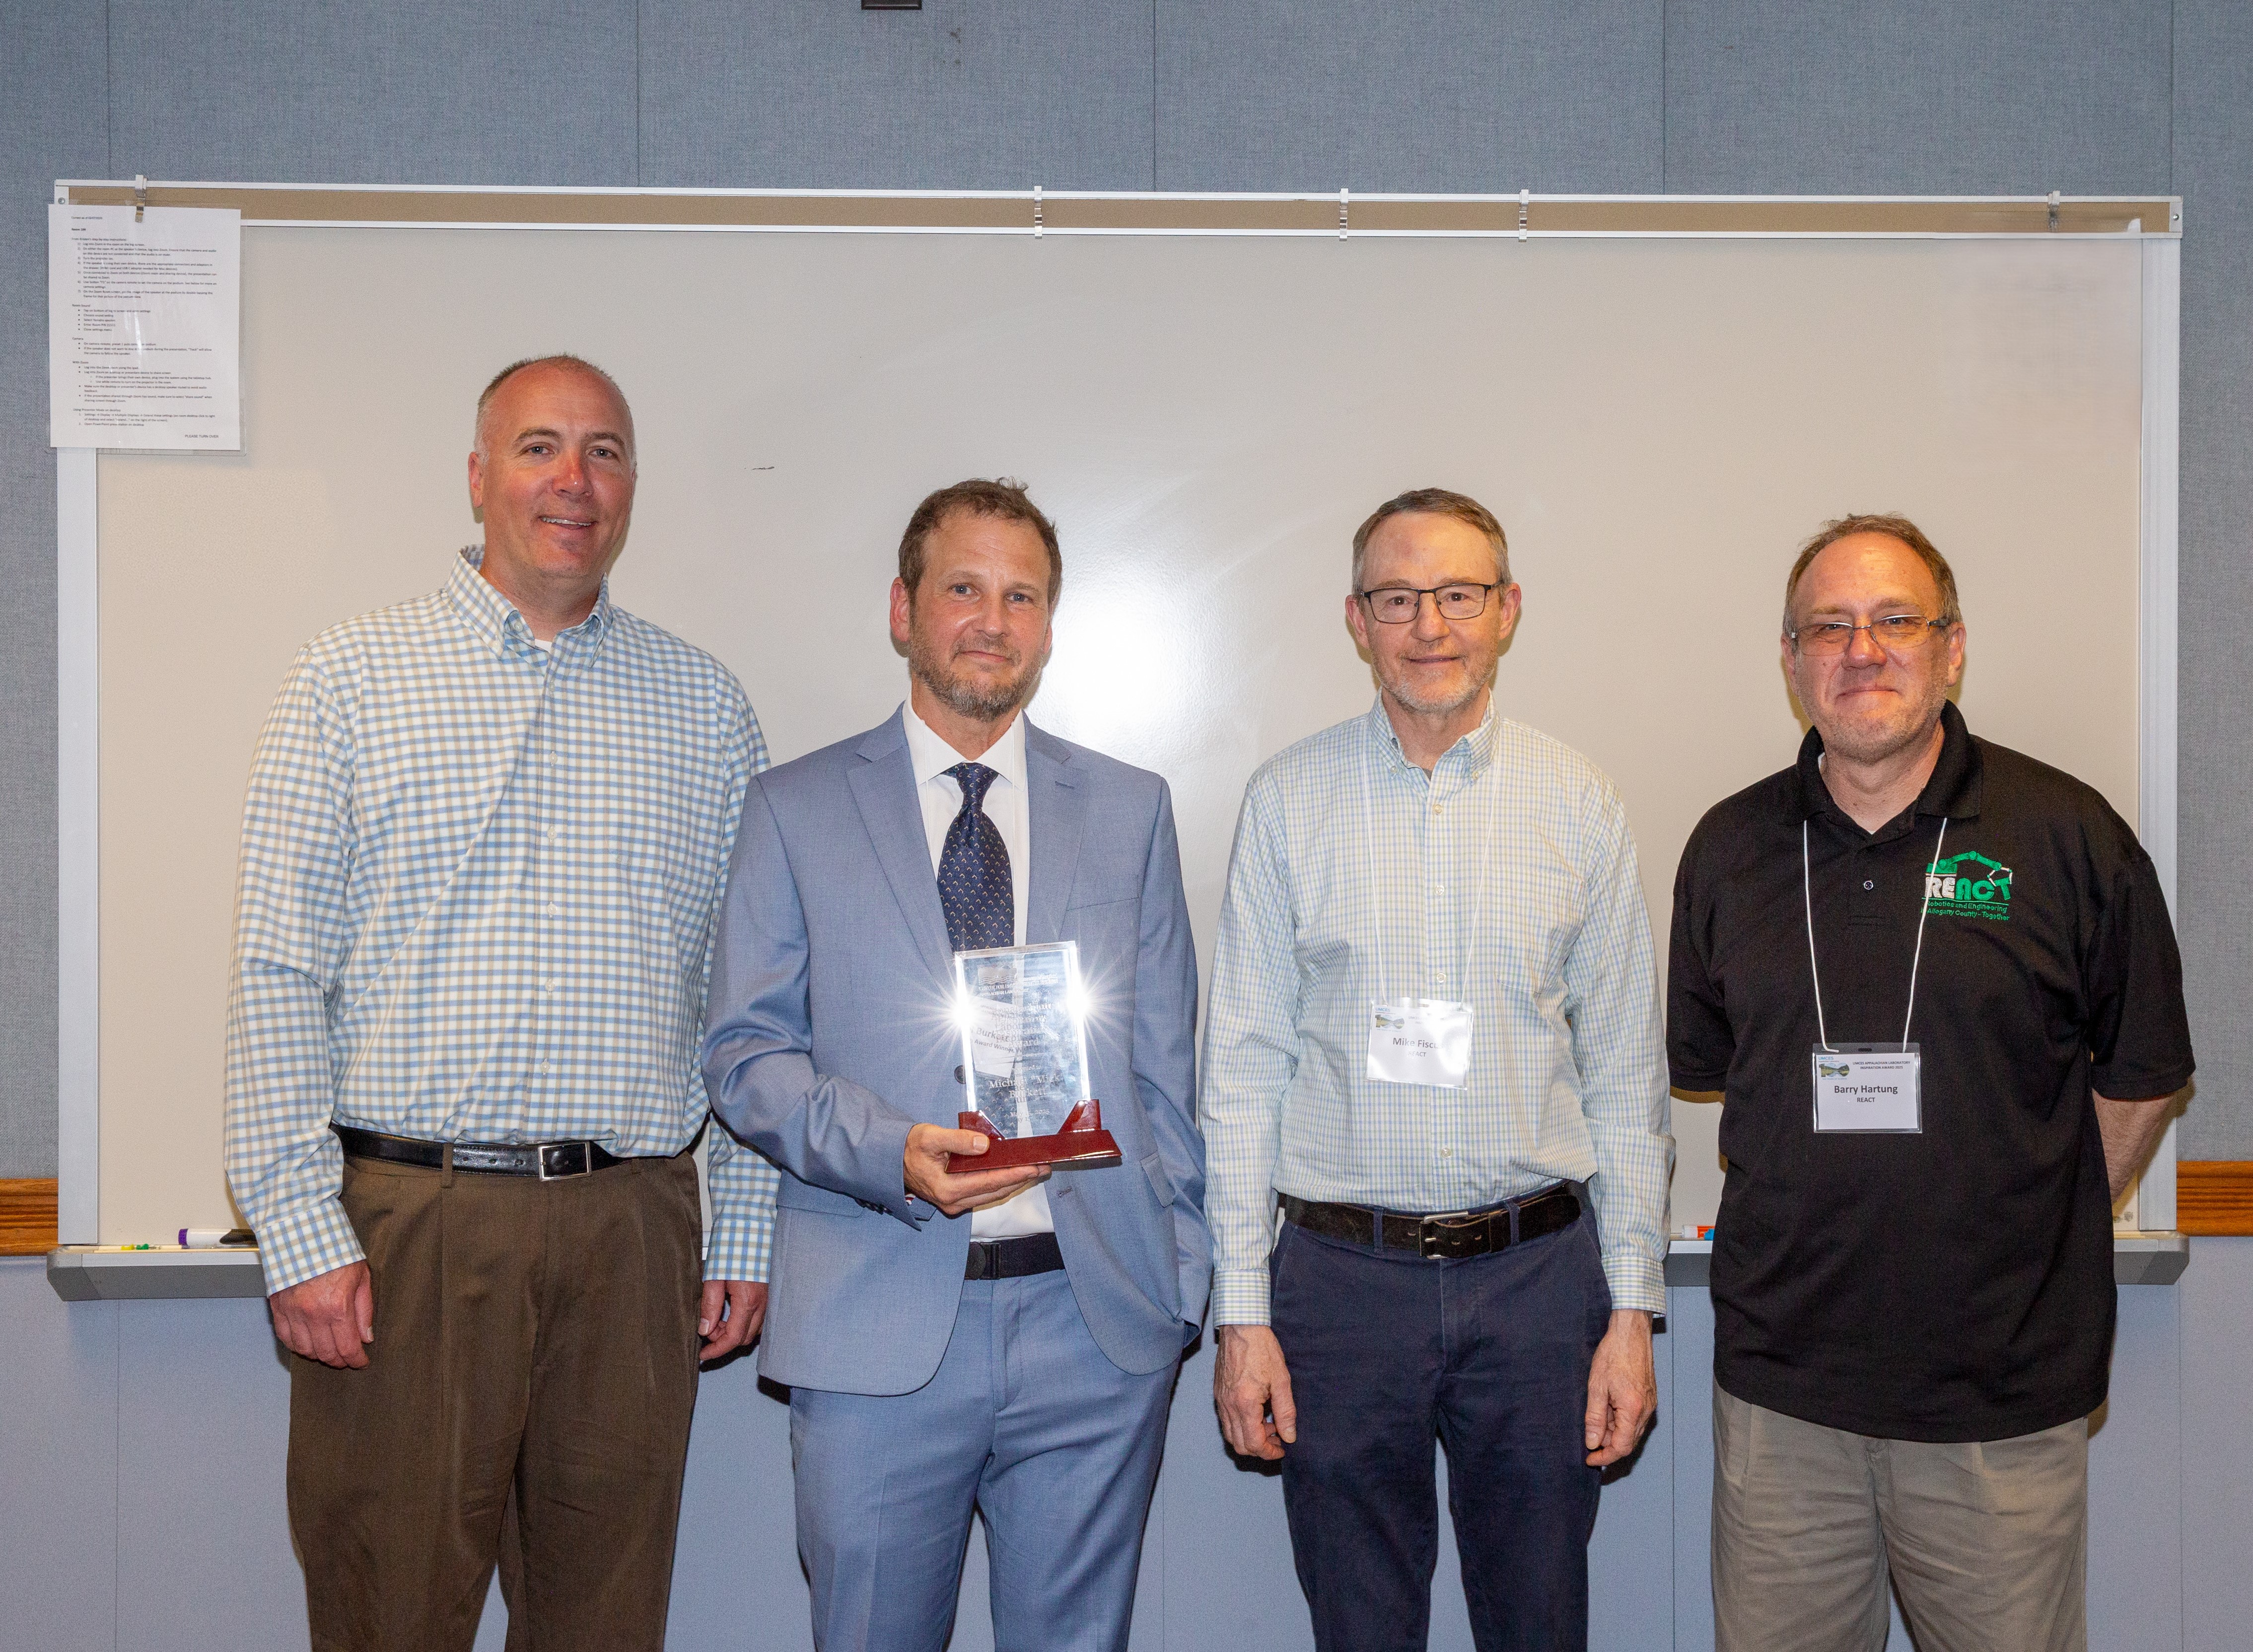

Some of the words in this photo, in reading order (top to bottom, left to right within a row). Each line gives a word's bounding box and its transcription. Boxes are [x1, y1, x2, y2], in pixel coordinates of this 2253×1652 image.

[1924, 877, 2011, 900] REACT
[1968, 903, 2007, 914] Engineering
[1981, 911, 2010, 921] Together
[974, 1039, 993, 1048] Award
[994, 1043, 1014, 1053] Winner
[1393, 1037, 1415, 1046] Mike
[1834, 1085, 1858, 1095] Barry
[1861, 1085, 1898, 1095] Hartung
